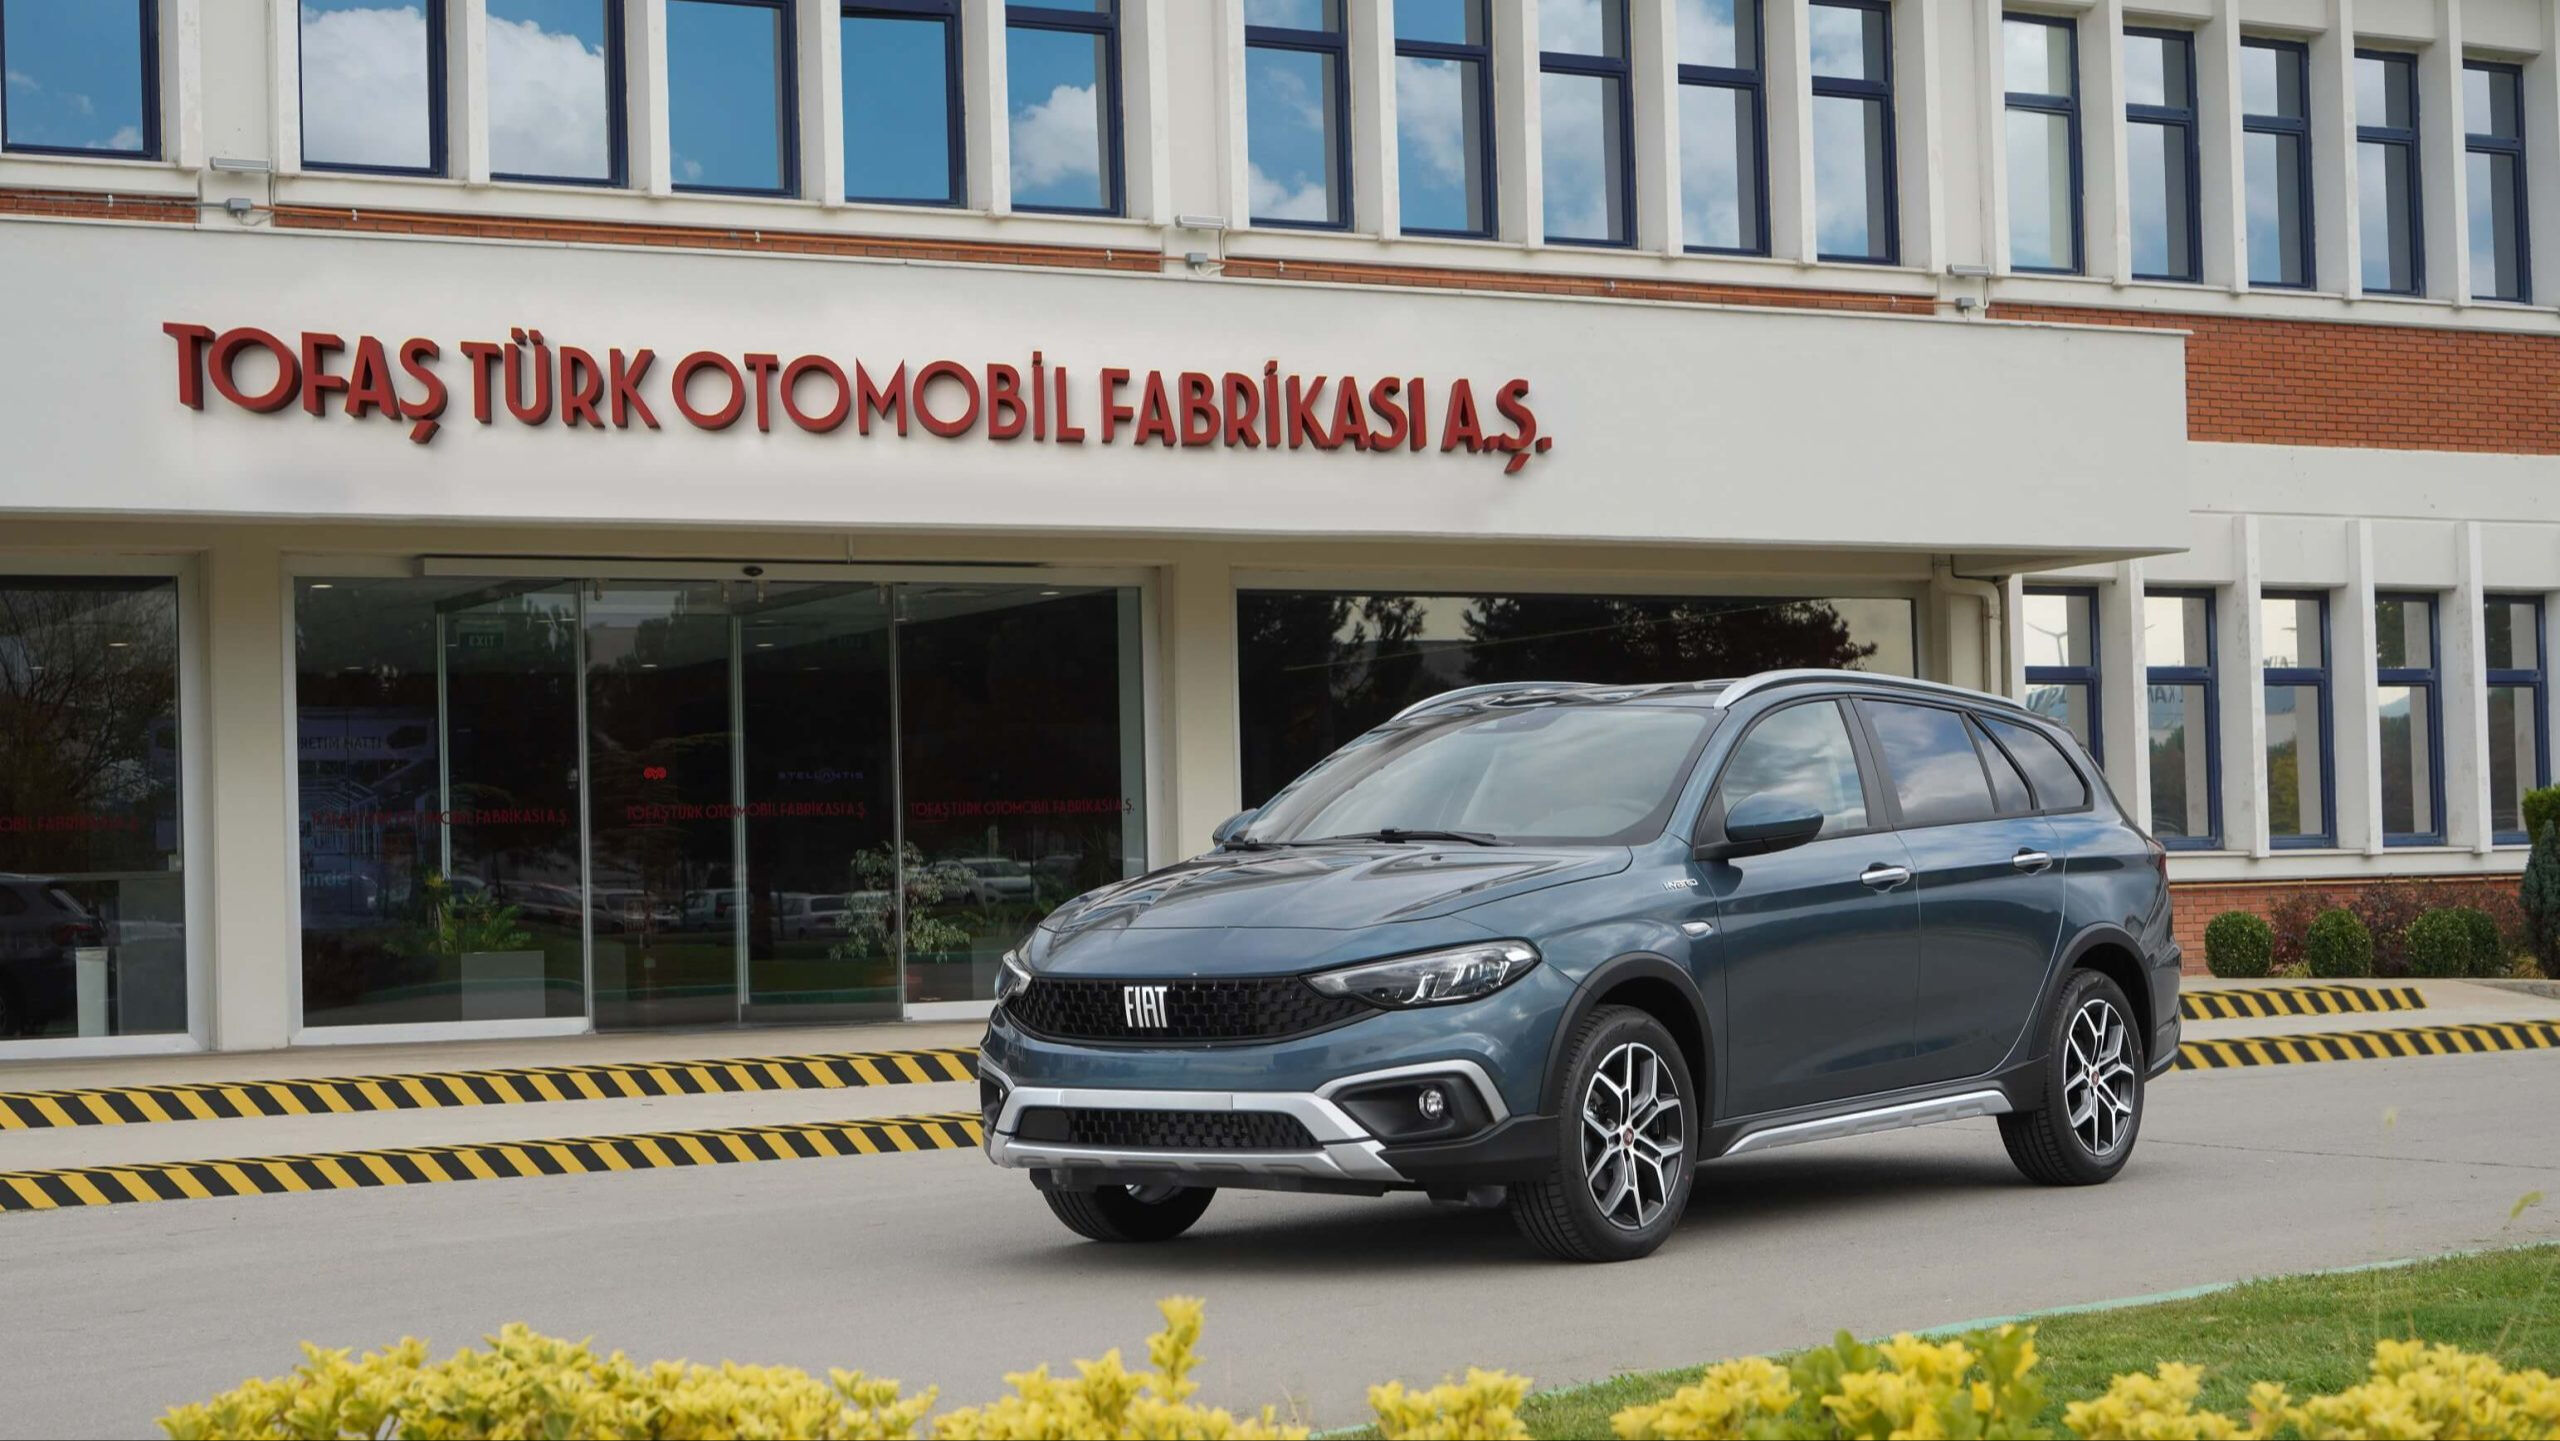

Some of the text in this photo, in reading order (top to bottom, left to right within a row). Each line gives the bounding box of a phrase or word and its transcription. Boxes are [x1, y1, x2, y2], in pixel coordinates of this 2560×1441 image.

[162, 321, 1554, 474] TOFAŞ TÜRK OTOMOBİL FABRİKASI A.Ş.
[468, 634, 495, 648] EXIT
[299, 735, 339, 750] RETİM
[1124, 986, 1168, 1028] FIAT
